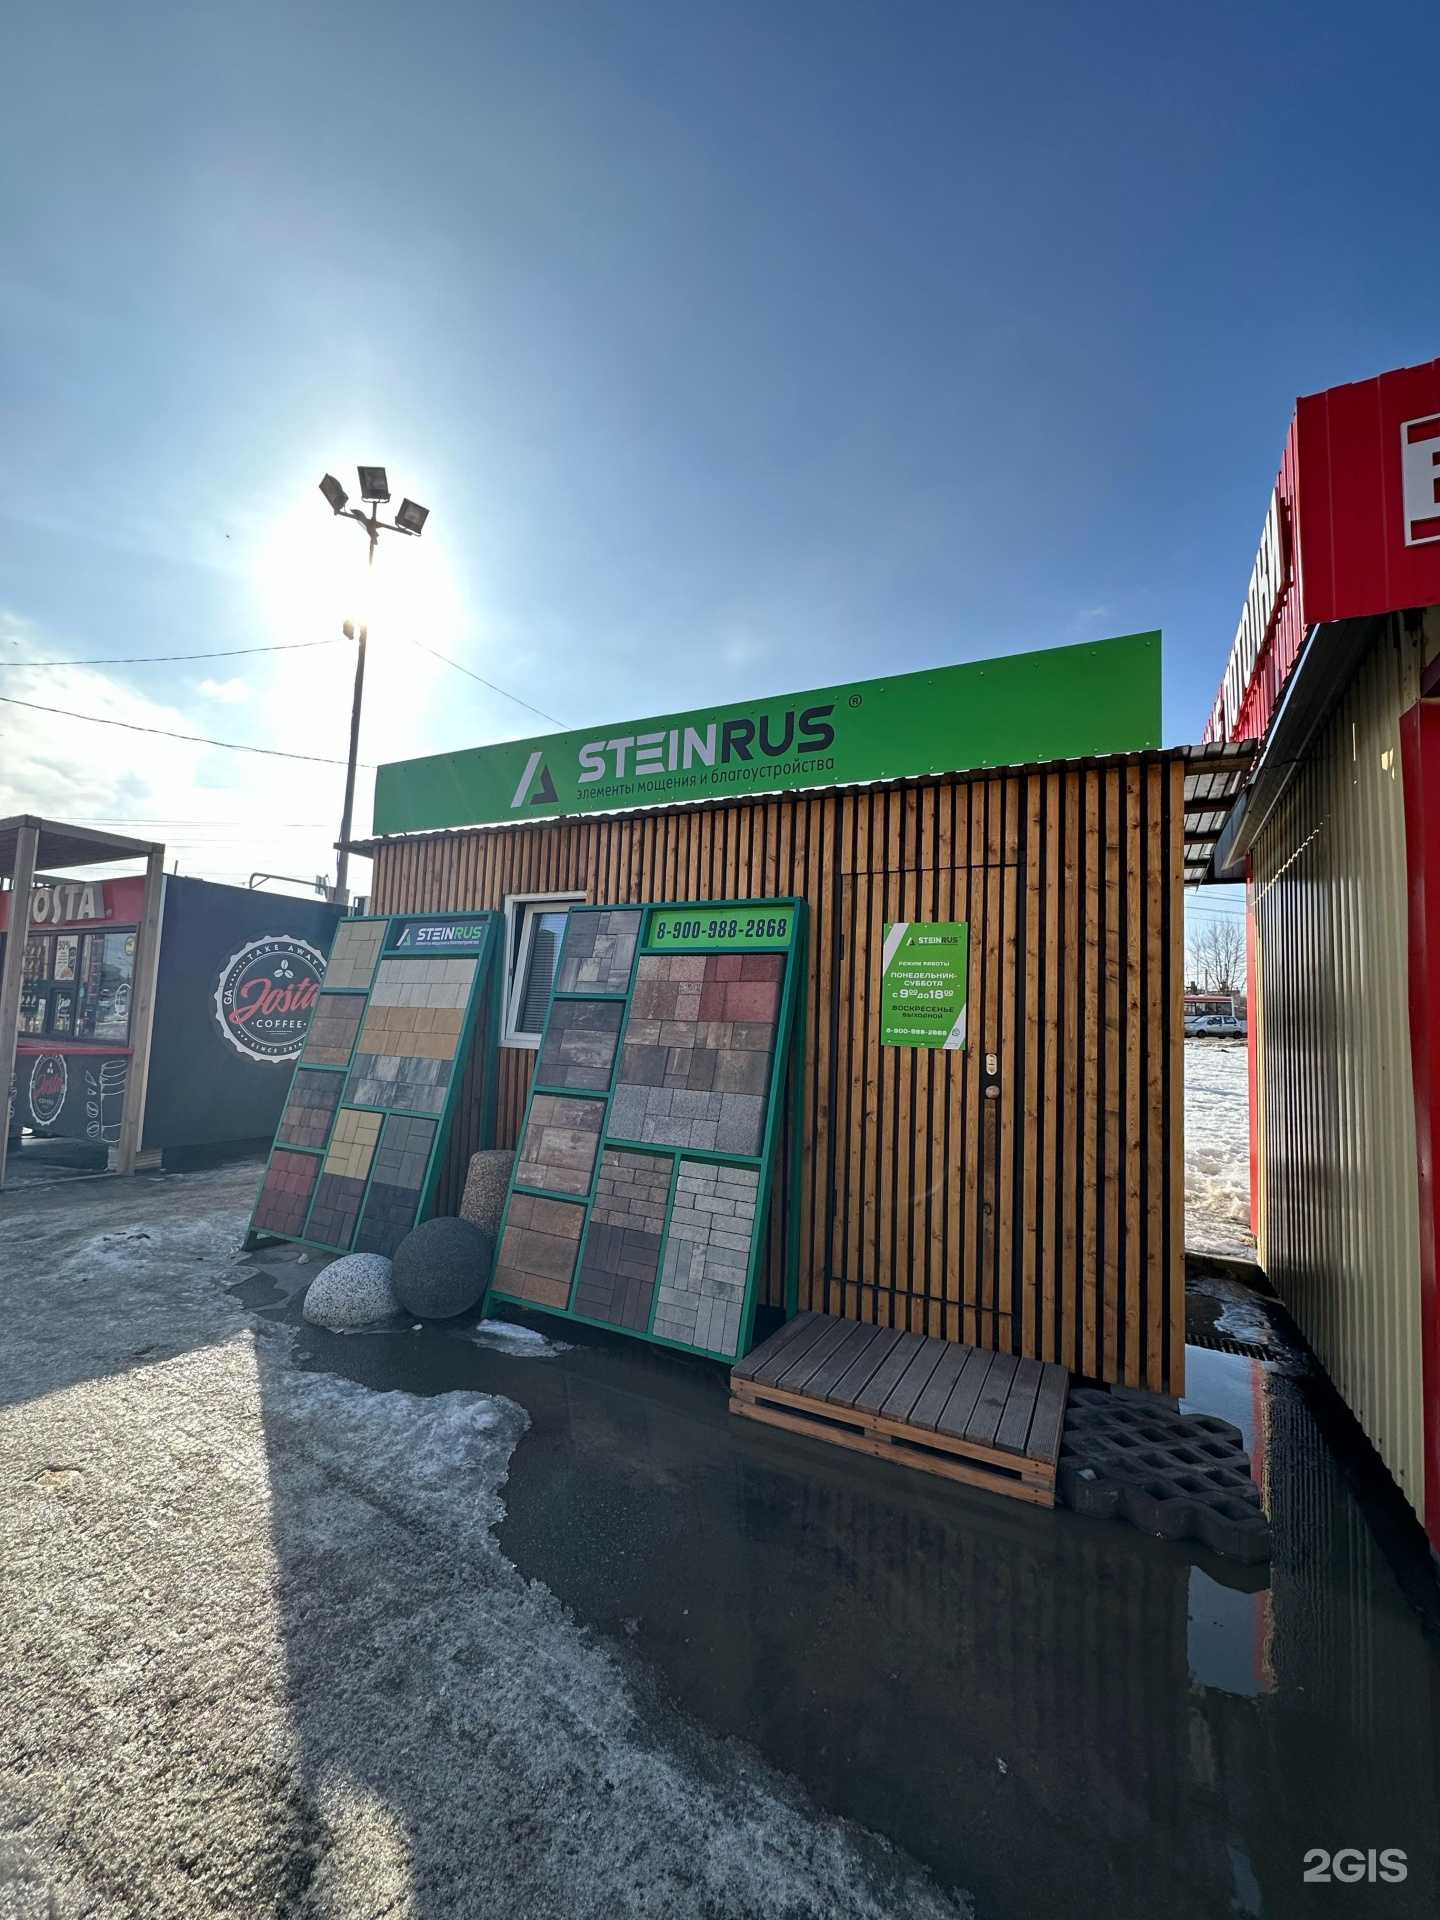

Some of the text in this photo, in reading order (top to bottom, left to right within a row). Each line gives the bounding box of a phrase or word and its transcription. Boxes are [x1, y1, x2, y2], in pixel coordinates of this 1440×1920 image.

[578, 704, 836, 784] STEINRUS
[576, 757, 835, 800] элементы мощения и благоустройства
[32, 885, 105, 924] OSTA
[417, 926, 482, 941] STEINRUS
[656, 918, 787, 939] 8-900-988-2868
[247, 944, 319, 965] TAKE AWAY
[892, 1005, 954, 1013] ВОСКРЕСЕНЬЕ
[256, 1019, 303, 1029] COFFEE
